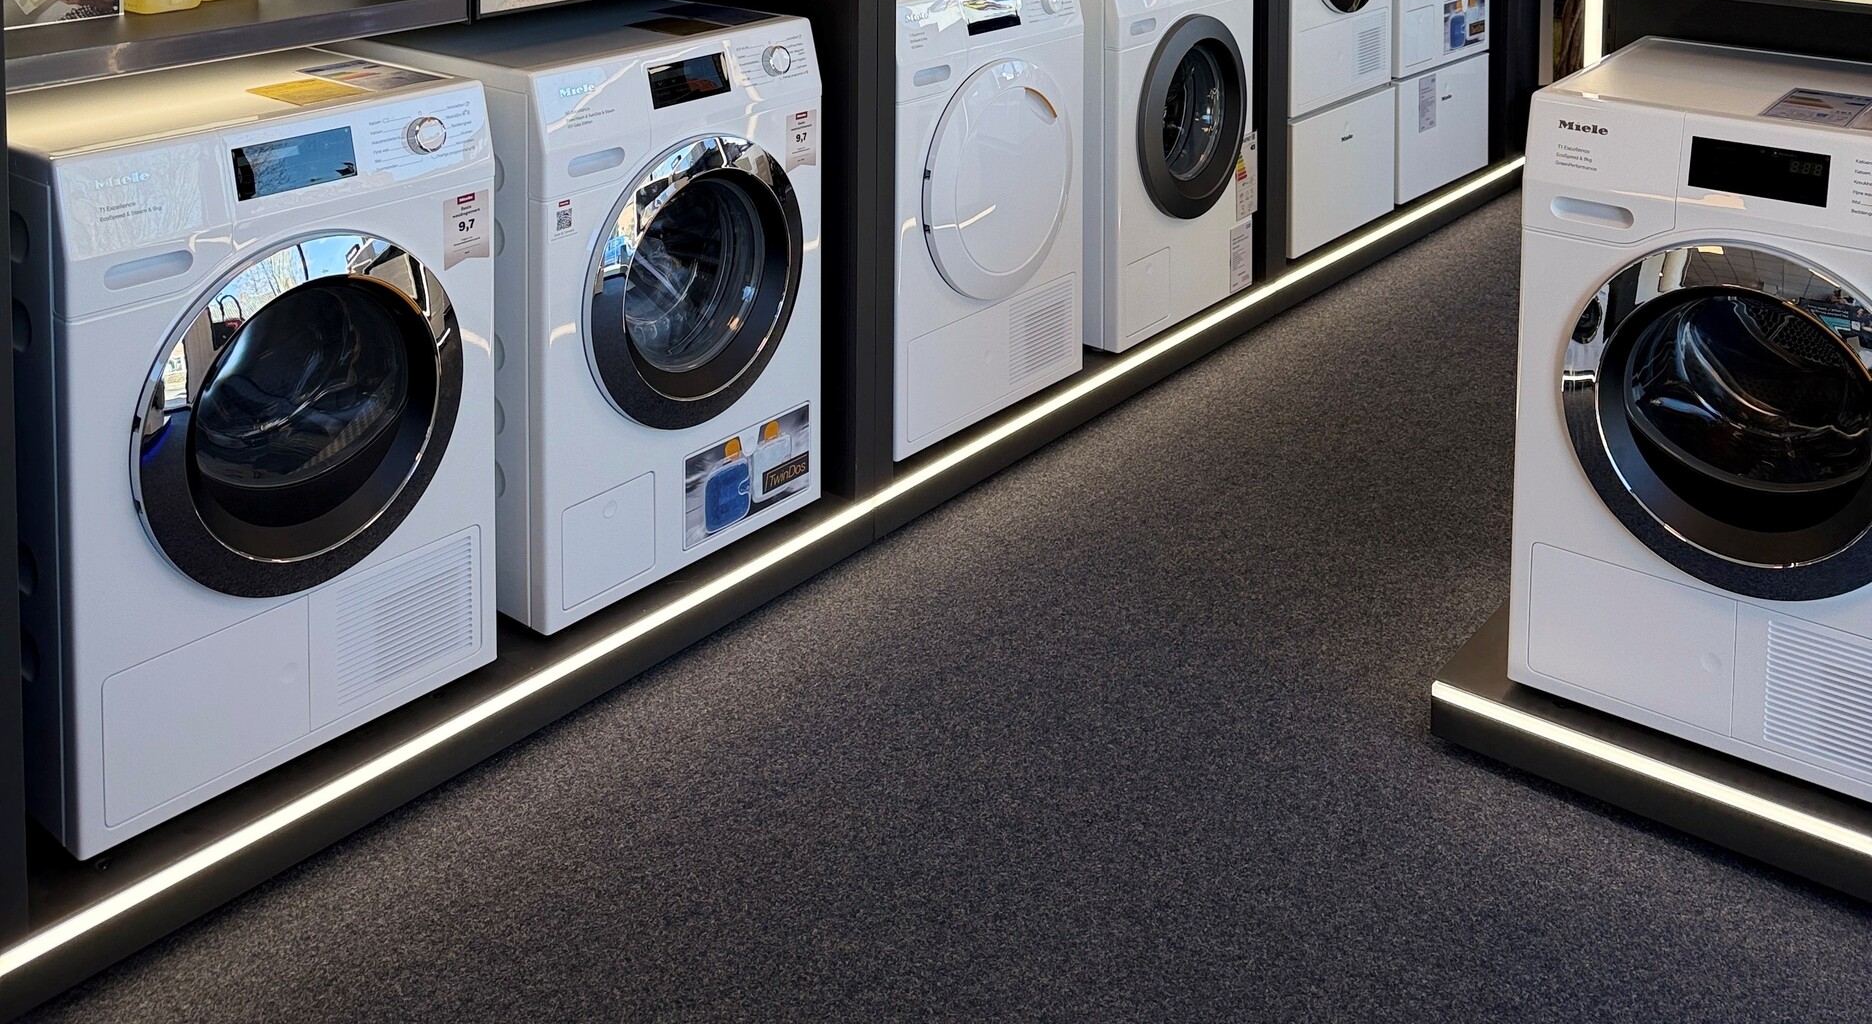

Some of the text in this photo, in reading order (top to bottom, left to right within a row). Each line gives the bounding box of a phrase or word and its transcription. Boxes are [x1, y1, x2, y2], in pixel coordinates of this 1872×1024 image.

[559, 84, 596, 98] Miele
[1559, 119, 1608, 135] Miele
[796, 132, 807, 143] 9,7
[1564, 145, 1590, 154] Excellence
[1556, 152, 1578, 160] EcoSpeed
[1555, 160, 1597, 171] GreenPerformance
[94, 171, 150, 190] Miele
[106, 202, 136, 212] Excellence
[100, 213, 125, 222] EcoSpeed
[458, 218, 475, 232] 9,7
[769, 461, 806, 487] TwinDos
